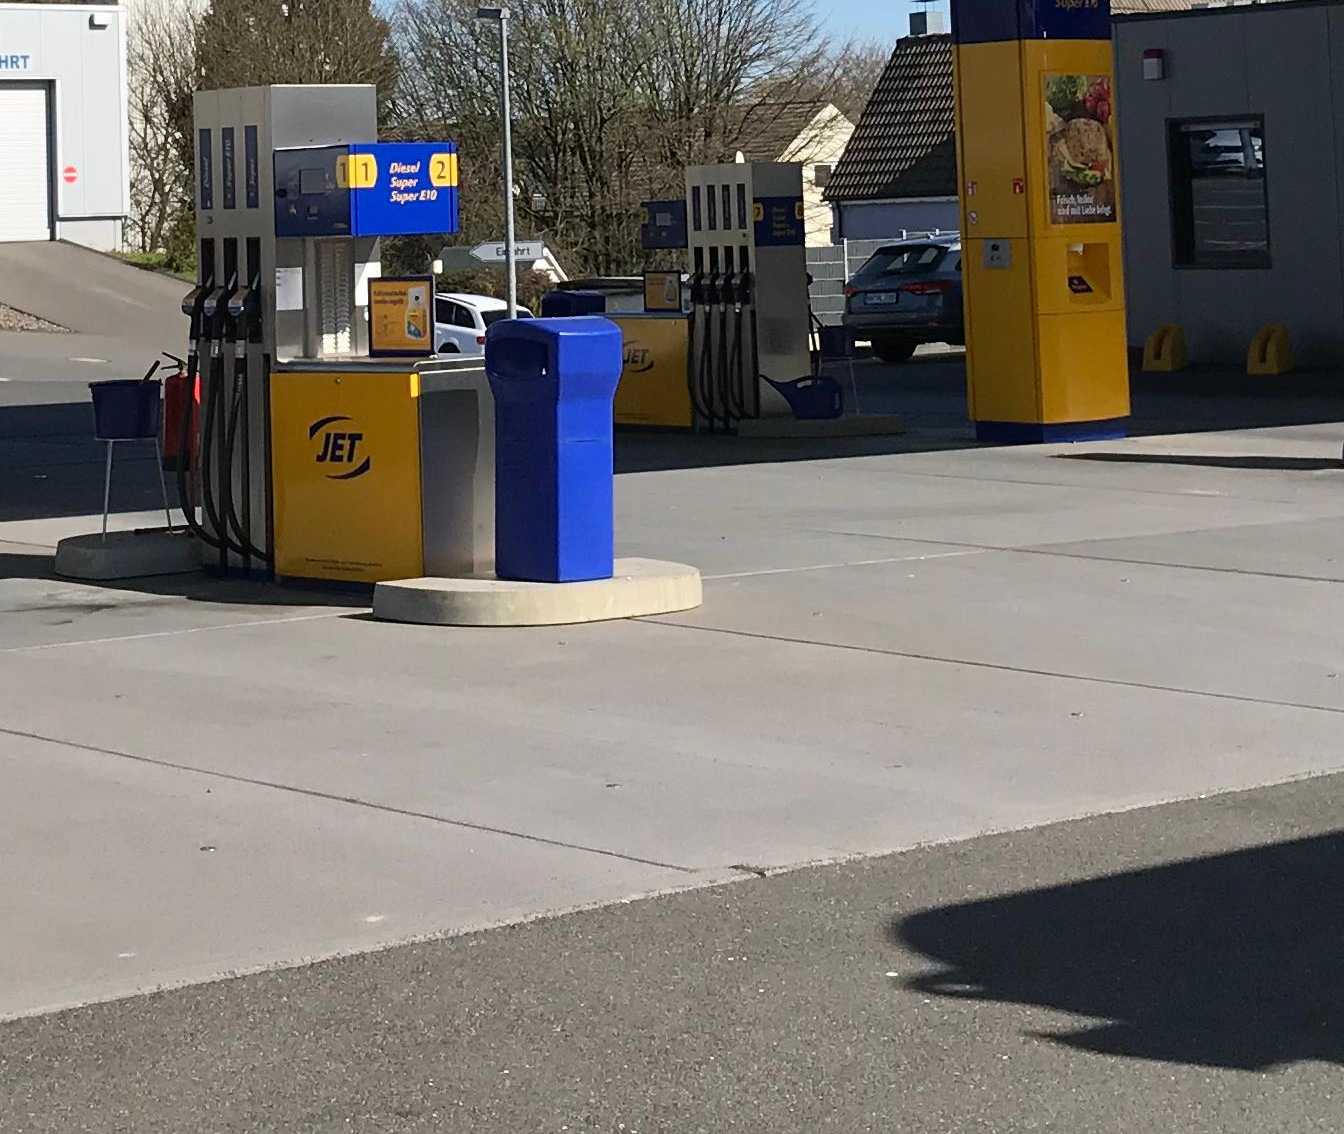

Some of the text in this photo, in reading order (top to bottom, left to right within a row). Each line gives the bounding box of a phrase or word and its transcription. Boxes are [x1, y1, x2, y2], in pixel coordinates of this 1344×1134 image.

[340, 162, 346, 182] 1
[361, 162, 369, 181] 1
[389, 161, 421, 174] Diesel
[436, 160, 446, 180] 2
[389, 176, 418, 190] Super
[389, 189, 438, 205] Super E10
[623, 348, 650, 364] JET
[315, 432, 364, 463] JET
